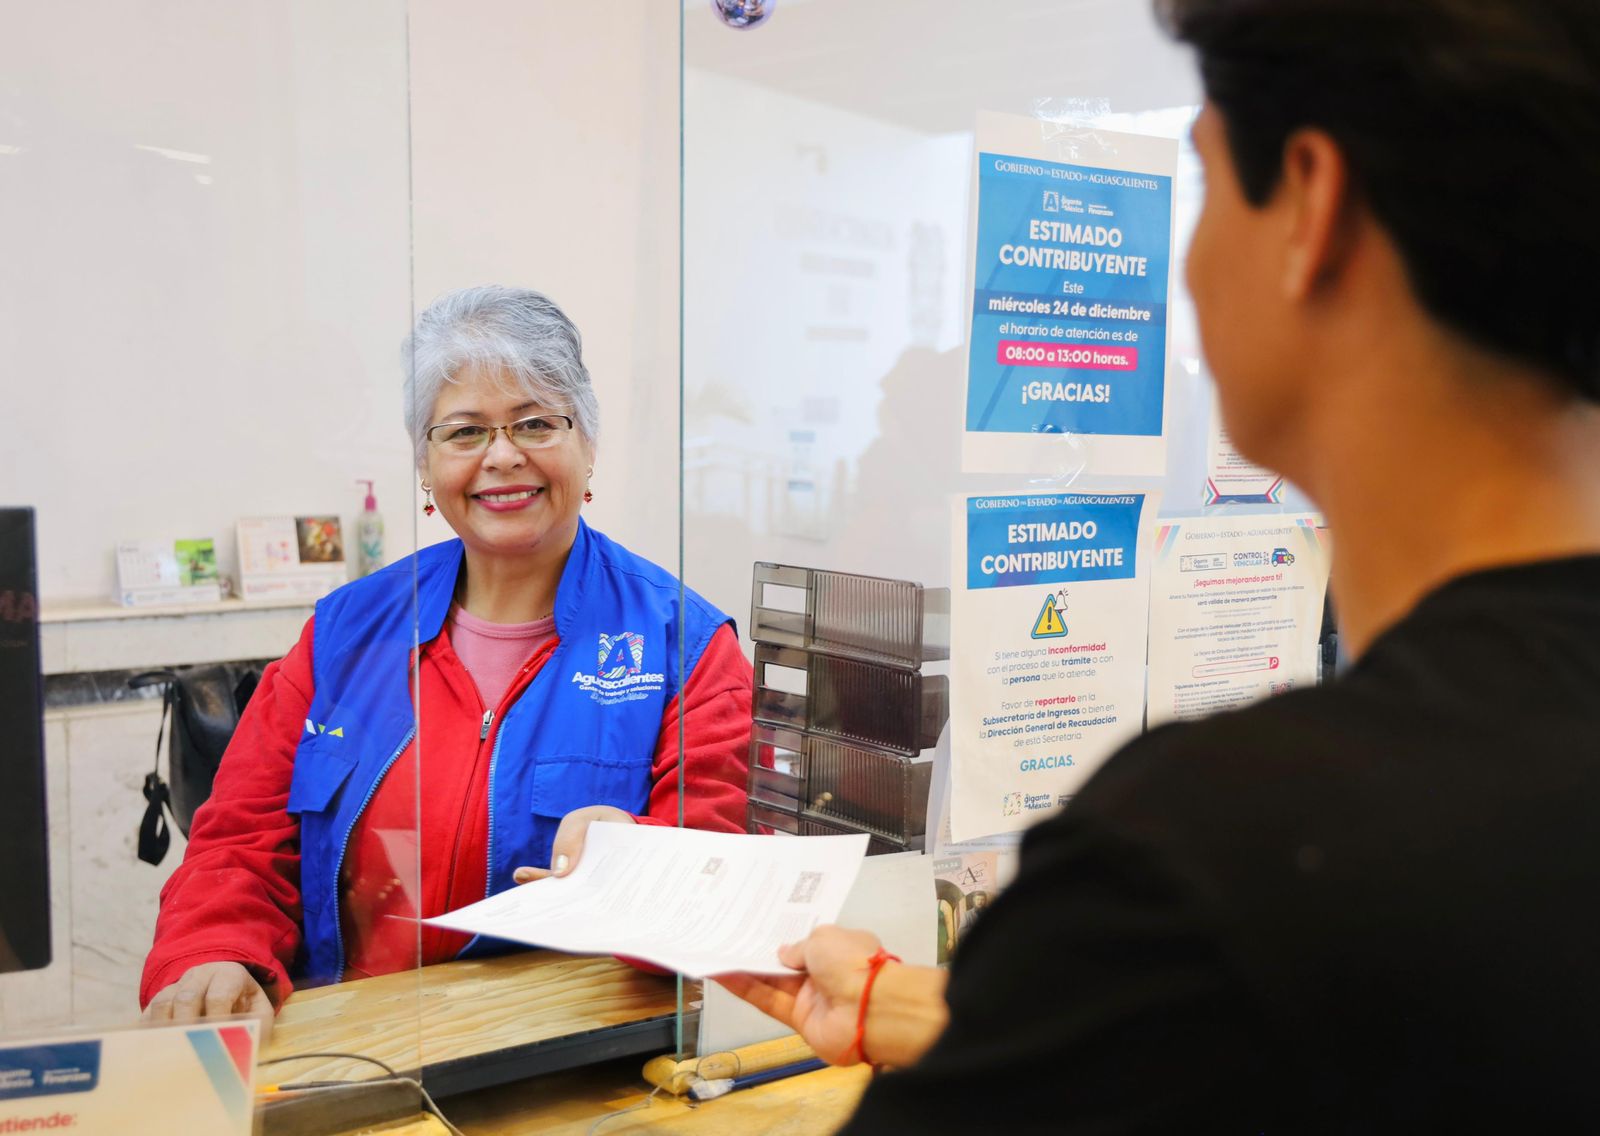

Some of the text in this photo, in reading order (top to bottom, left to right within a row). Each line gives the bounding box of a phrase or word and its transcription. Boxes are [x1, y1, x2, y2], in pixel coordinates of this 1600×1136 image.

[994, 159, 1158, 190] GOBIERNO ESTADO AGUASCALIENTES
[1029, 219, 1122, 248] ESTIMADO
[999, 244, 1147, 277] CONTRIBUYENTE
[1063, 281, 1084, 294] Este
[989, 297, 1150, 321] miércoles 24 de diciembre
[1000, 323, 1138, 342] el horario de atención es de
[1005, 346, 1129, 366] 08:00 a 13:00 horas.
[1022, 381, 1110, 404] ¡GRACIAS!
[975, 498, 1020, 509] GOBIERNO
[1027, 497, 1057, 507] ESTADO
[1063, 495, 1136, 505] AGUASCALIENTES
[1007, 521, 1097, 544] ESTIMADO
[980, 547, 1123, 575] CONTRIBUYENTE
[1233, 552, 1262, 560] CONTROL
[1193, 577, 1225, 588] ¡Seguimos
[1226, 575, 1260, 586] mejorando
[1261, 574, 1275, 583] para
[995, 643, 1106, 661] Si tiene alguna inconformidad
[987, 666, 1000, 674] con
[1002, 663, 1008, 672] el
[1009, 661, 1039, 674] proceso
[1040, 660, 1050, 669] de
[1051, 660, 1060, 668] su
[1061, 656, 1091, 666] trámite
[1099, 655, 1113, 663] con
[572, 671, 665, 690] Aguascalientes
[1002, 676, 1008, 685] la
[1009, 674, 1040, 686] persona
[1042, 672, 1056, 682] que
[1058, 671, 1065, 679] lo
[1002, 700, 1022, 710] Favor
[1024, 699, 1034, 708] de
[1035, 694, 1076, 707] reportarlo
[1088, 693, 1096, 701] la
[982, 711, 1035, 726] Subsecretaría
[1036, 709, 1046, 719] de
[1047, 707, 1080, 719] Ingresos
[1088, 704, 1103, 714] bien
[987, 725, 1024, 738] Dirección
[1025, 722, 1055, 734] General
[1057, 720, 1067, 730] de
[1068, 715, 1117, 728] Recaudación
[1014, 738, 1024, 747] de
[1025, 736, 1040, 745] esta
[1020, 755, 1075, 772] GRACIAS.
